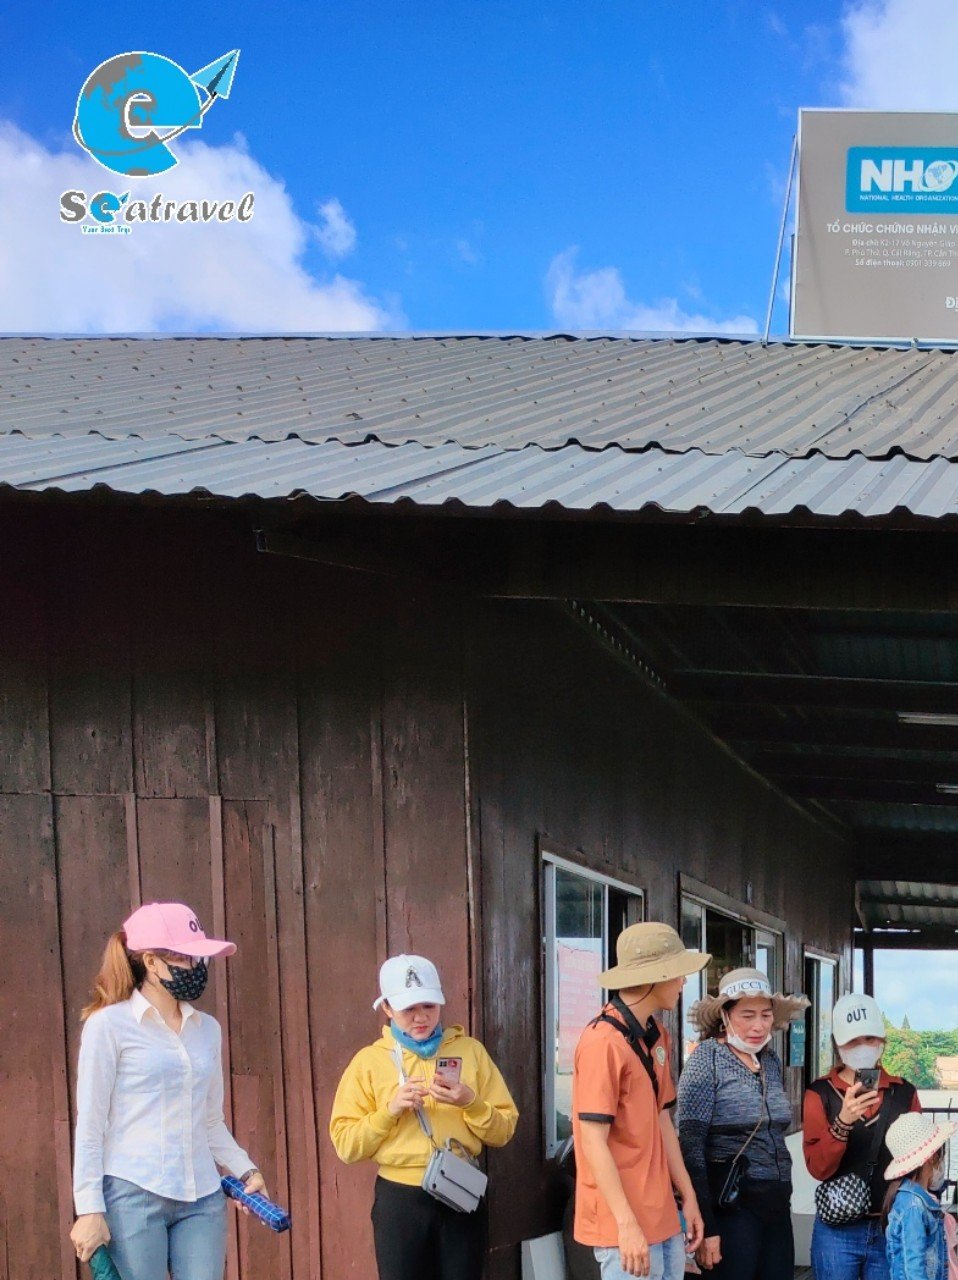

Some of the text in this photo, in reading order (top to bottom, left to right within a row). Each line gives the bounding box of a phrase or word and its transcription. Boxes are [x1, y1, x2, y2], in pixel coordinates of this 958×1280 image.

[859, 194, 890, 202] NATIONAL
[892, 194, 913, 202] HEALTH
[826, 220, 840, 233] TỔ
[843, 221, 874, 234] CHỨC
[876, 221, 915, 235] CHỨNG
[916, 222, 946, 236] NHẬN
[405, 965, 424, 989] A
[846, 1008, 868, 1024] OUT
